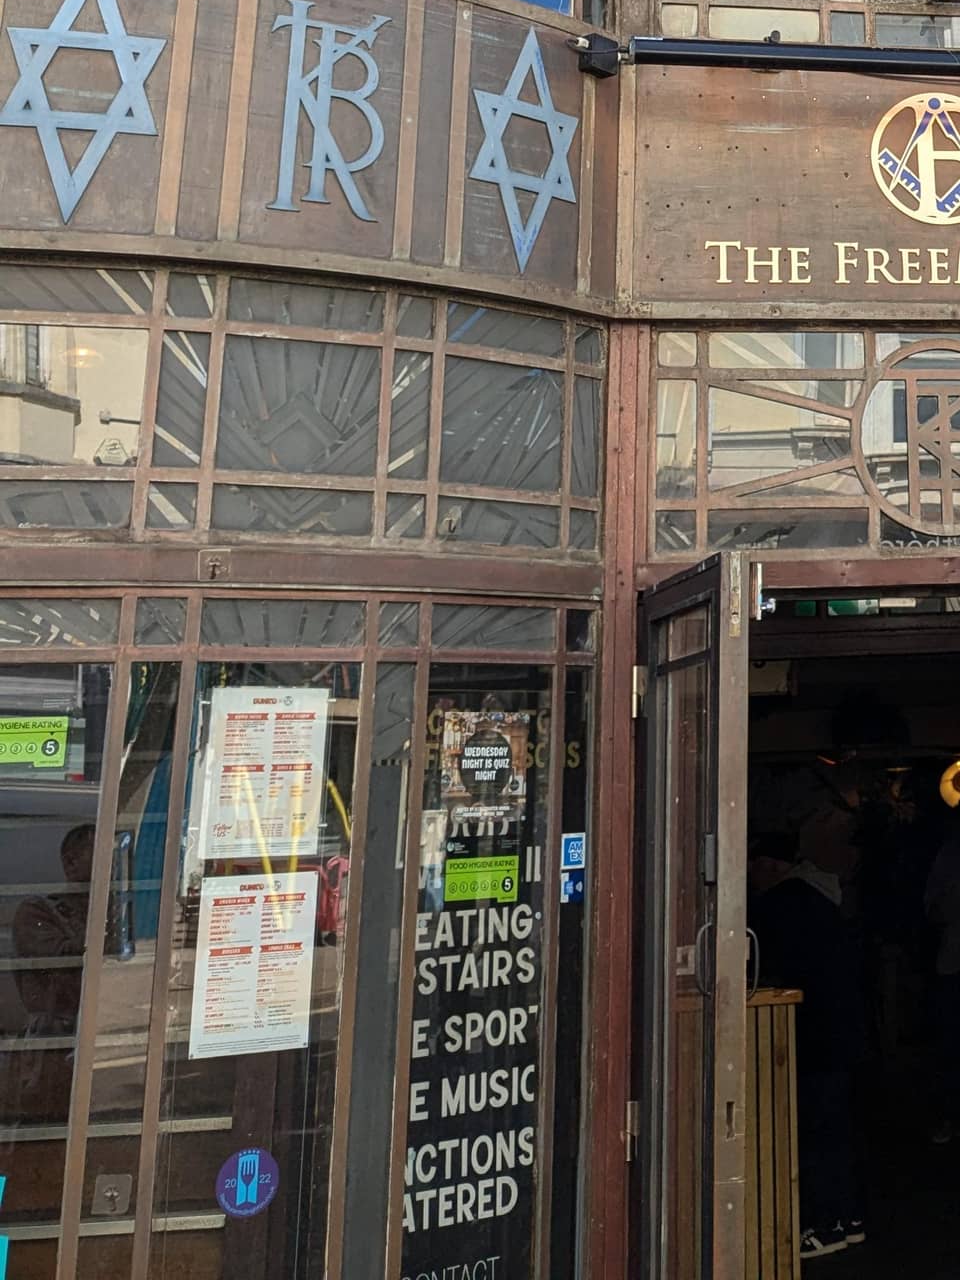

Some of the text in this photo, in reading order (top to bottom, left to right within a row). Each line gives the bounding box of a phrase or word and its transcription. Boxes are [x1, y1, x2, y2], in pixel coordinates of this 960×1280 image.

[704, 240, 812, 284] THE
[0, 720, 62, 730] YGIENE RATING
[45, 741, 55, 755] 5
[464, 746, 508, 757] WEDNESDAY
[462, 758, 509, 769] NIGHT IS QUIZ
[475, 771, 496, 781] NIGHT
[415, 904, 533, 951] EATING
[416, 947, 535, 995] STAIRS
[441, 1064, 535, 1118] MUSIC
[404, 1126, 534, 1186] NCTIONS
[224, 1173, 271, 1189] 20 22
[402, 1176, 518, 1233] ATERED
